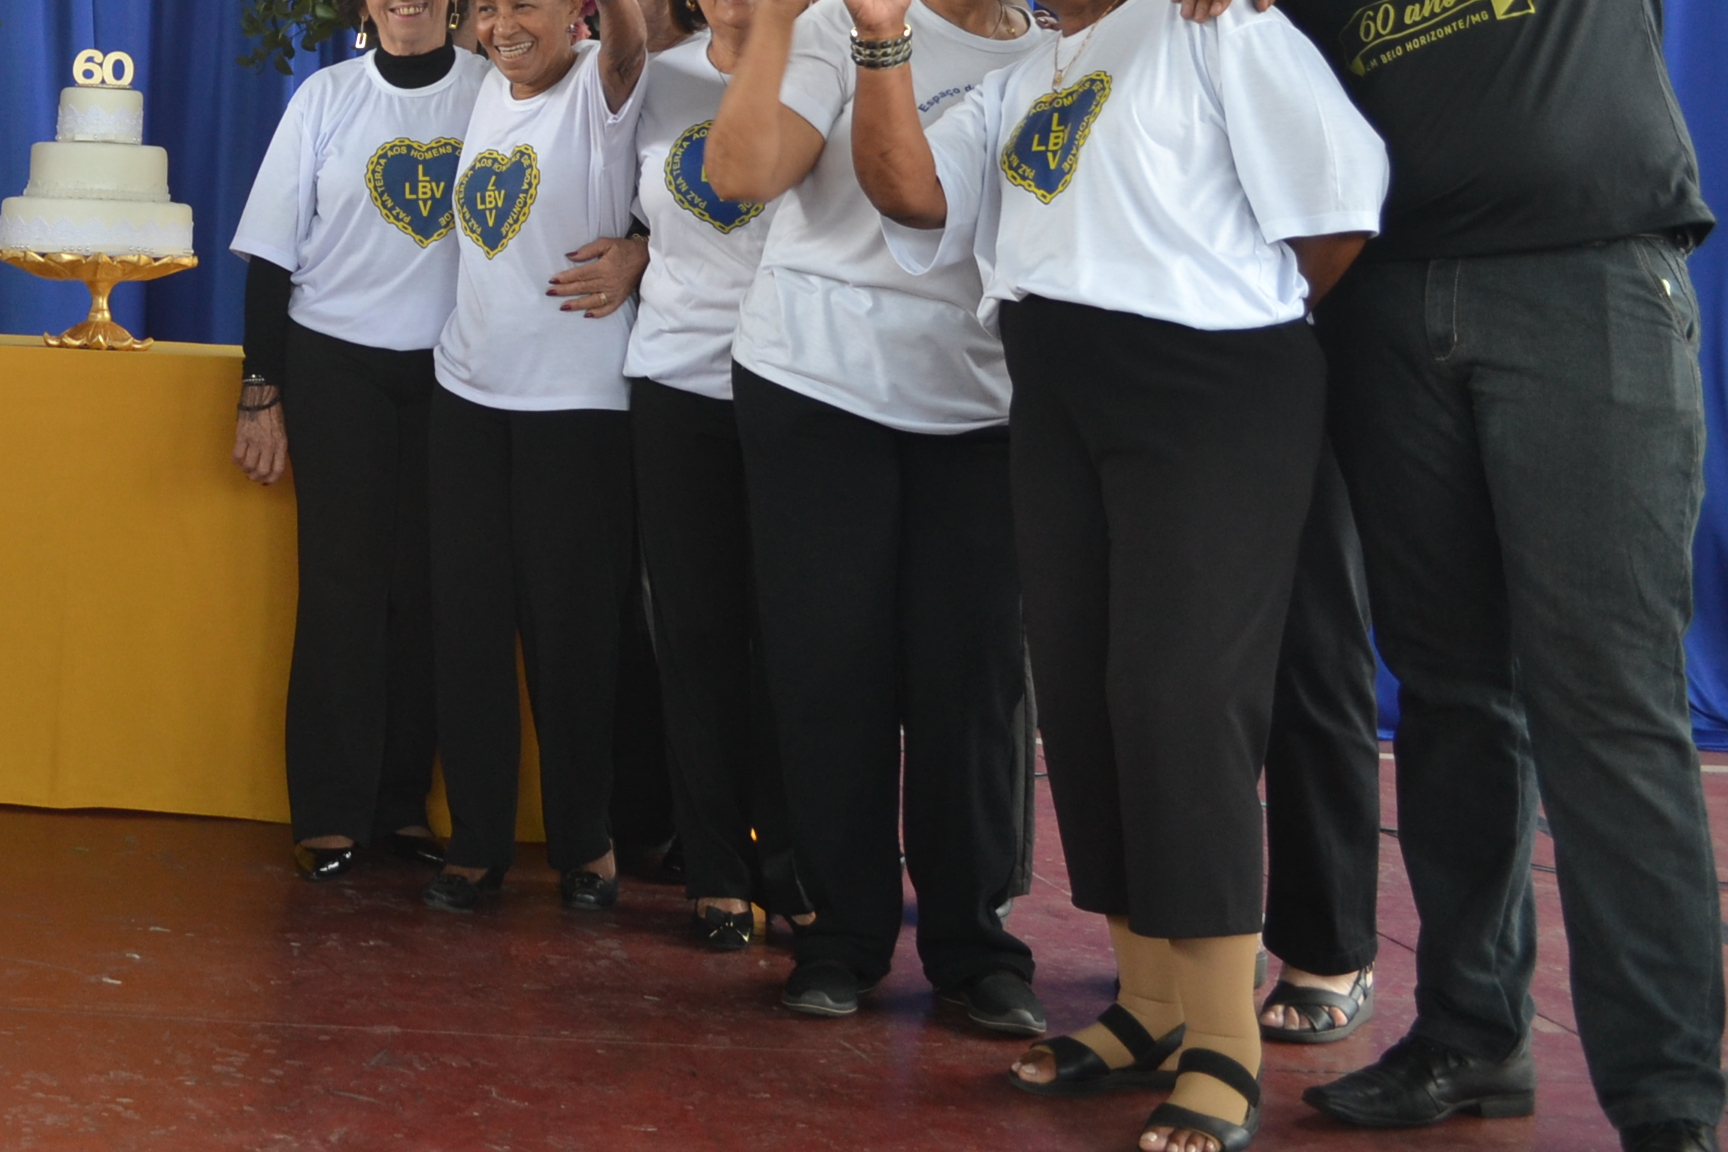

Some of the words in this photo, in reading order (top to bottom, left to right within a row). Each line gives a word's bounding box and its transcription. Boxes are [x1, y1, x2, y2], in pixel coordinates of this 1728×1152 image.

[1359, 3, 1395, 43] 60
[1380, 45, 1403, 64] BELO
[1405, 10, 1489, 53] HORIZONTE/MG
[72, 48, 135, 86] 60
[917, 86, 961, 113] Espaço
[964, 84, 975, 93] d
[692, 129, 711, 141] AO
[387, 146, 407, 158] AOS
[410, 145, 453, 160] HOMENS
[375, 158, 387, 193] TERRA
[675, 176, 689, 192] NA
[405, 181, 445, 199] LBV
[475, 158, 493, 170] AOS
[501, 193, 526, 236] VONTADE
[476, 189, 505, 210] LBV
[382, 193, 394, 208] NA
[686, 191, 708, 210] PAZ
[392, 206, 411, 223] PAZ
